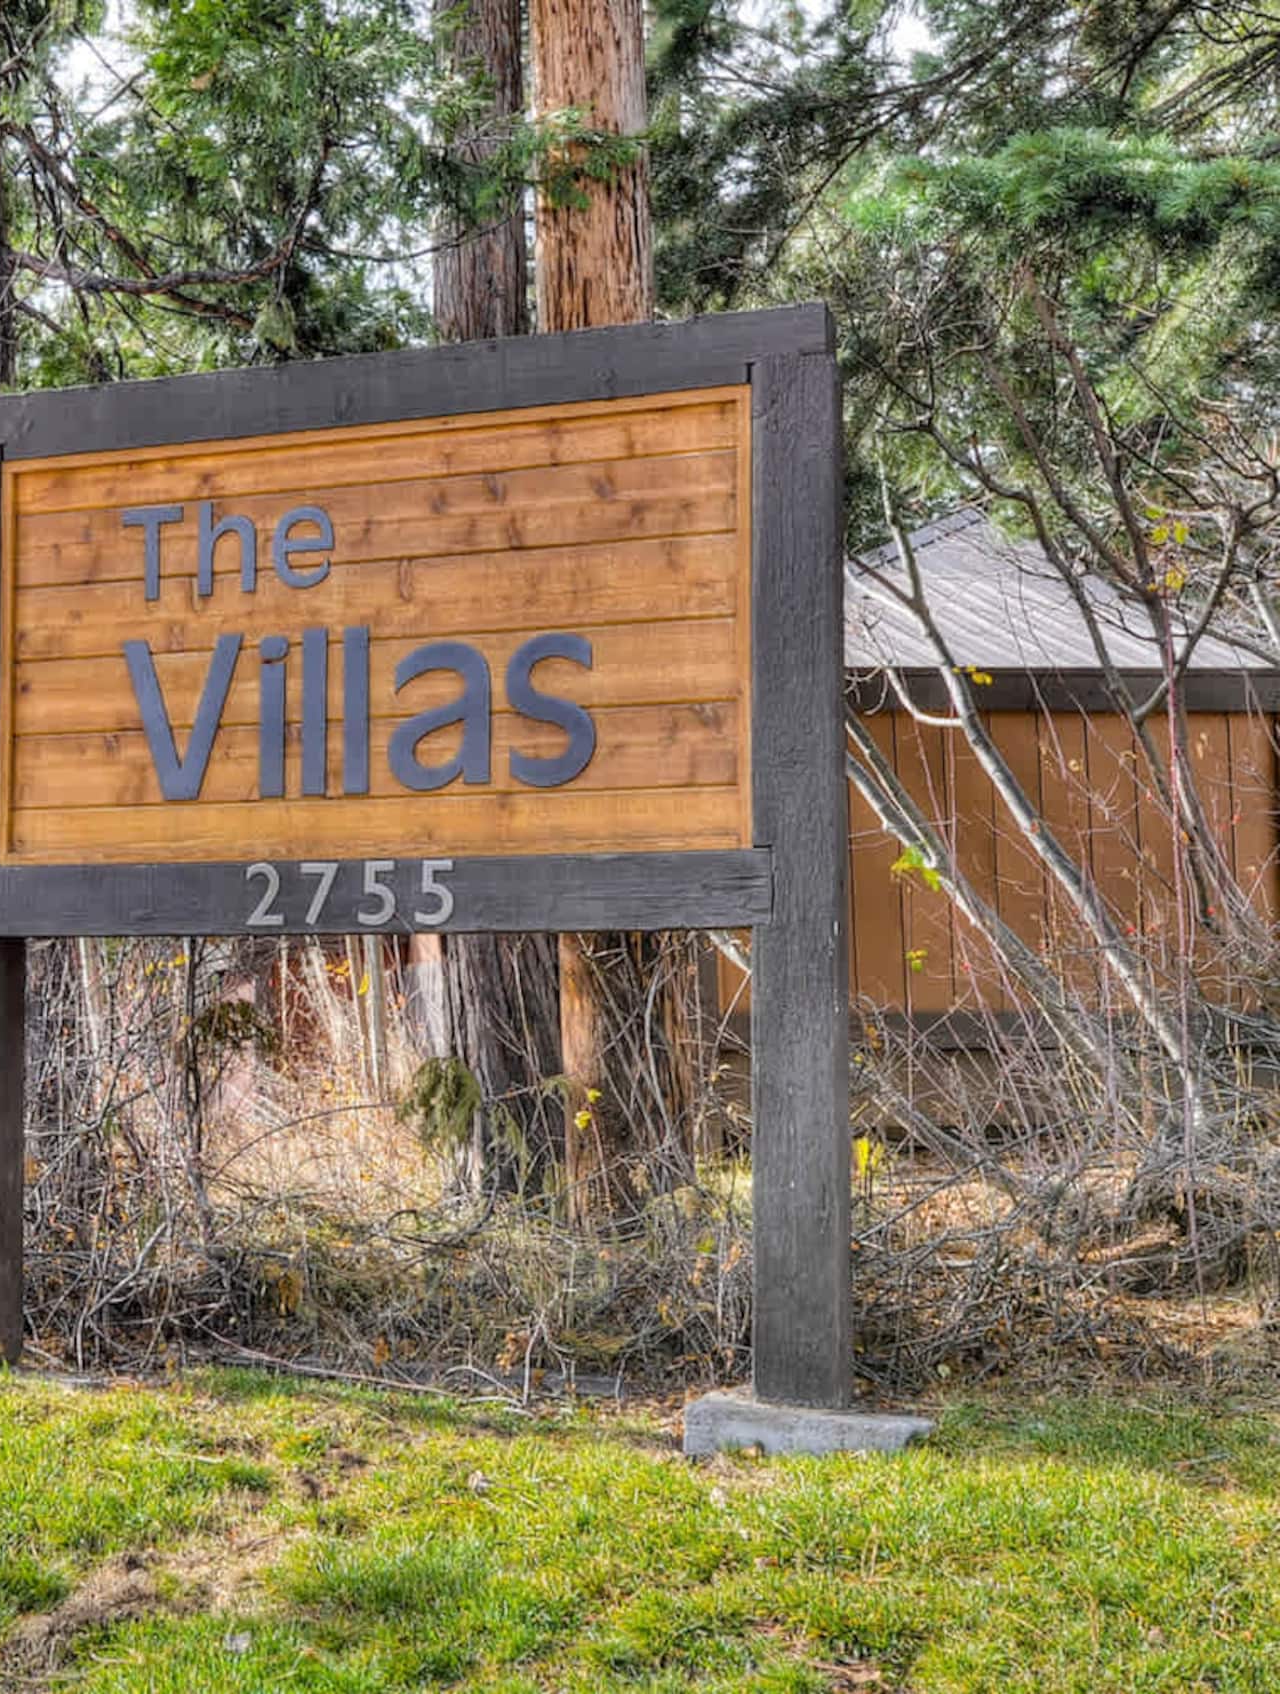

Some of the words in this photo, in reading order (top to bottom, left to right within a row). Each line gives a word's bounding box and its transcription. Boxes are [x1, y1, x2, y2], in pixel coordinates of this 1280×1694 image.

[121, 501, 335, 601] The
[123, 624, 597, 802] Villas
[244, 858, 455, 927] 2755
